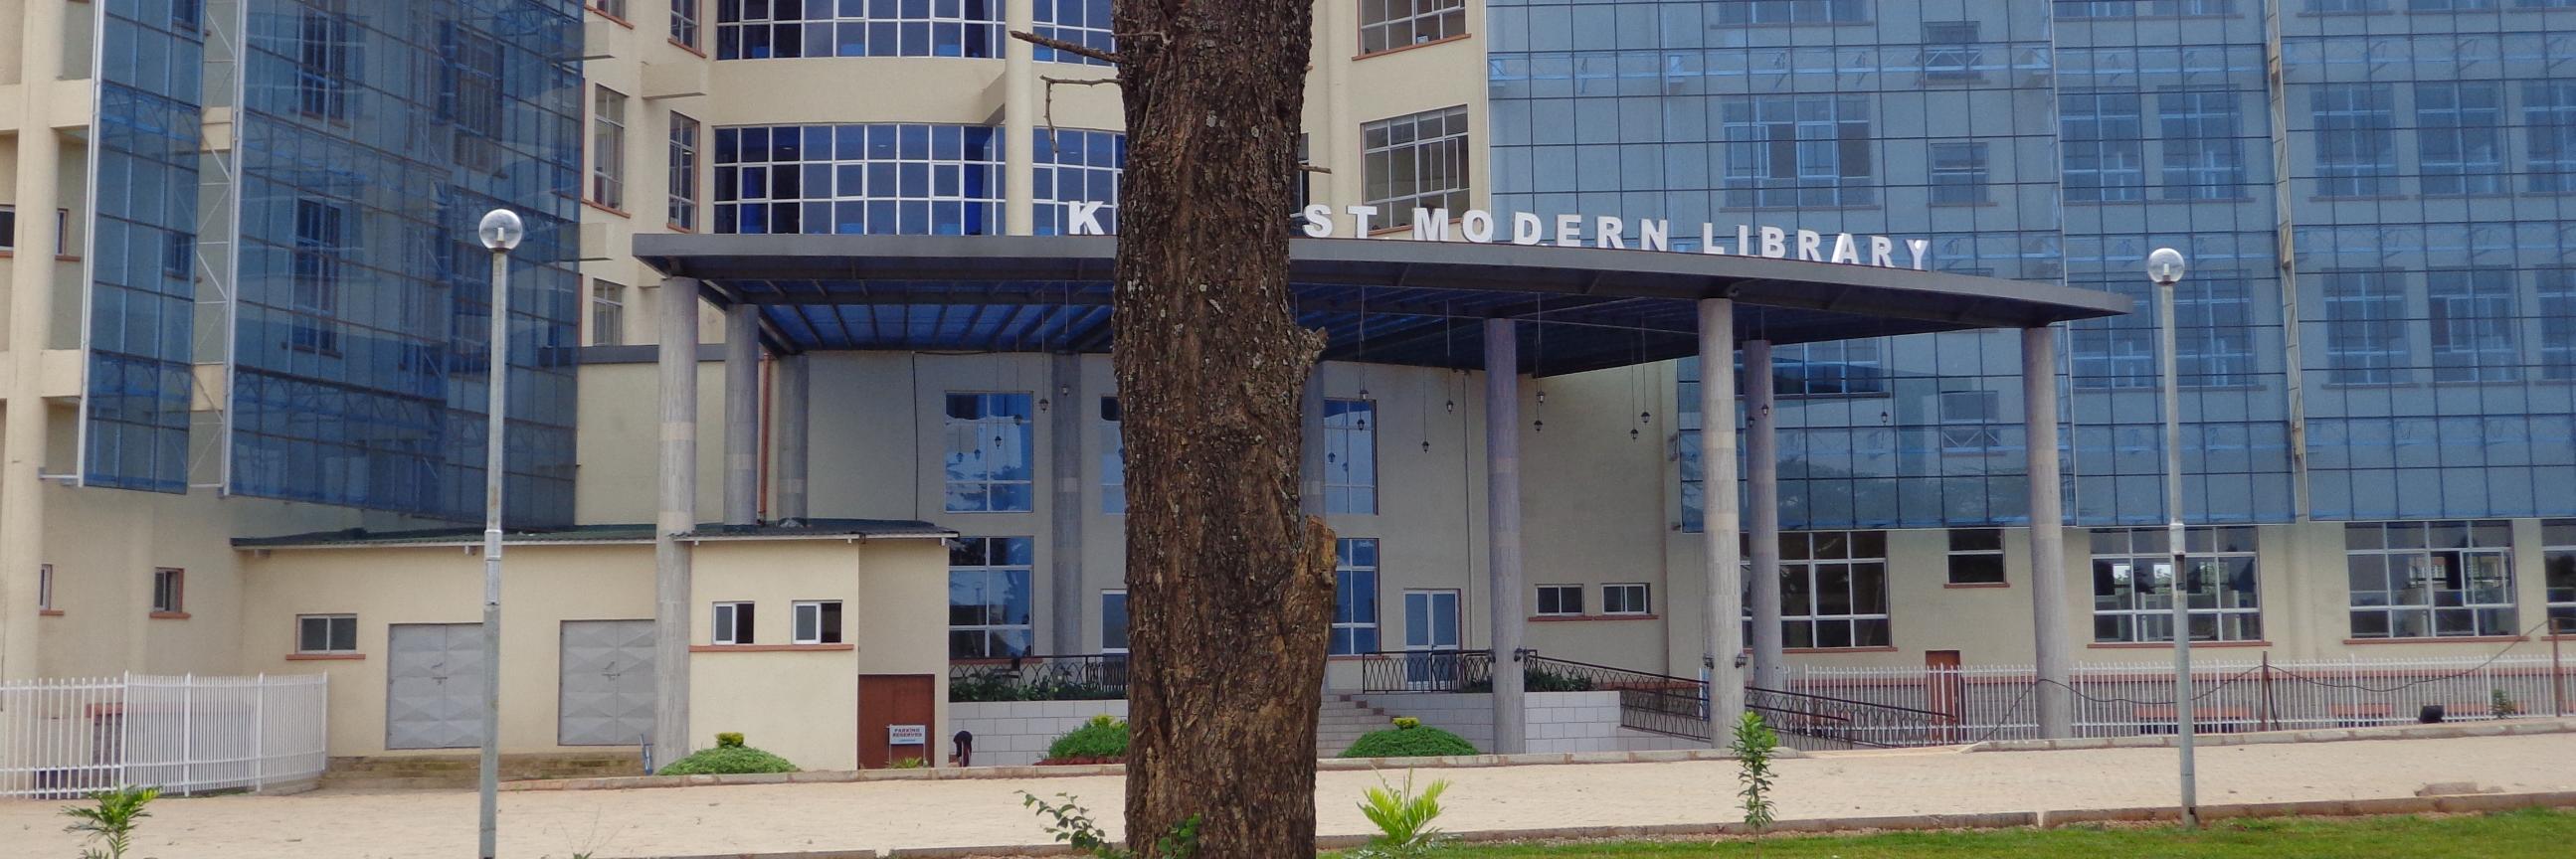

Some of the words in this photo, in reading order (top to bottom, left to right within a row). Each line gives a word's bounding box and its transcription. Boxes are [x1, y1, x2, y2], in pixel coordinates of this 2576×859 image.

[1068, 200, 1105, 236] K
[1303, 204, 1378, 240] ST
[1413, 207, 1669, 252] MODERN
[1702, 222, 1931, 270] LIBRARY
